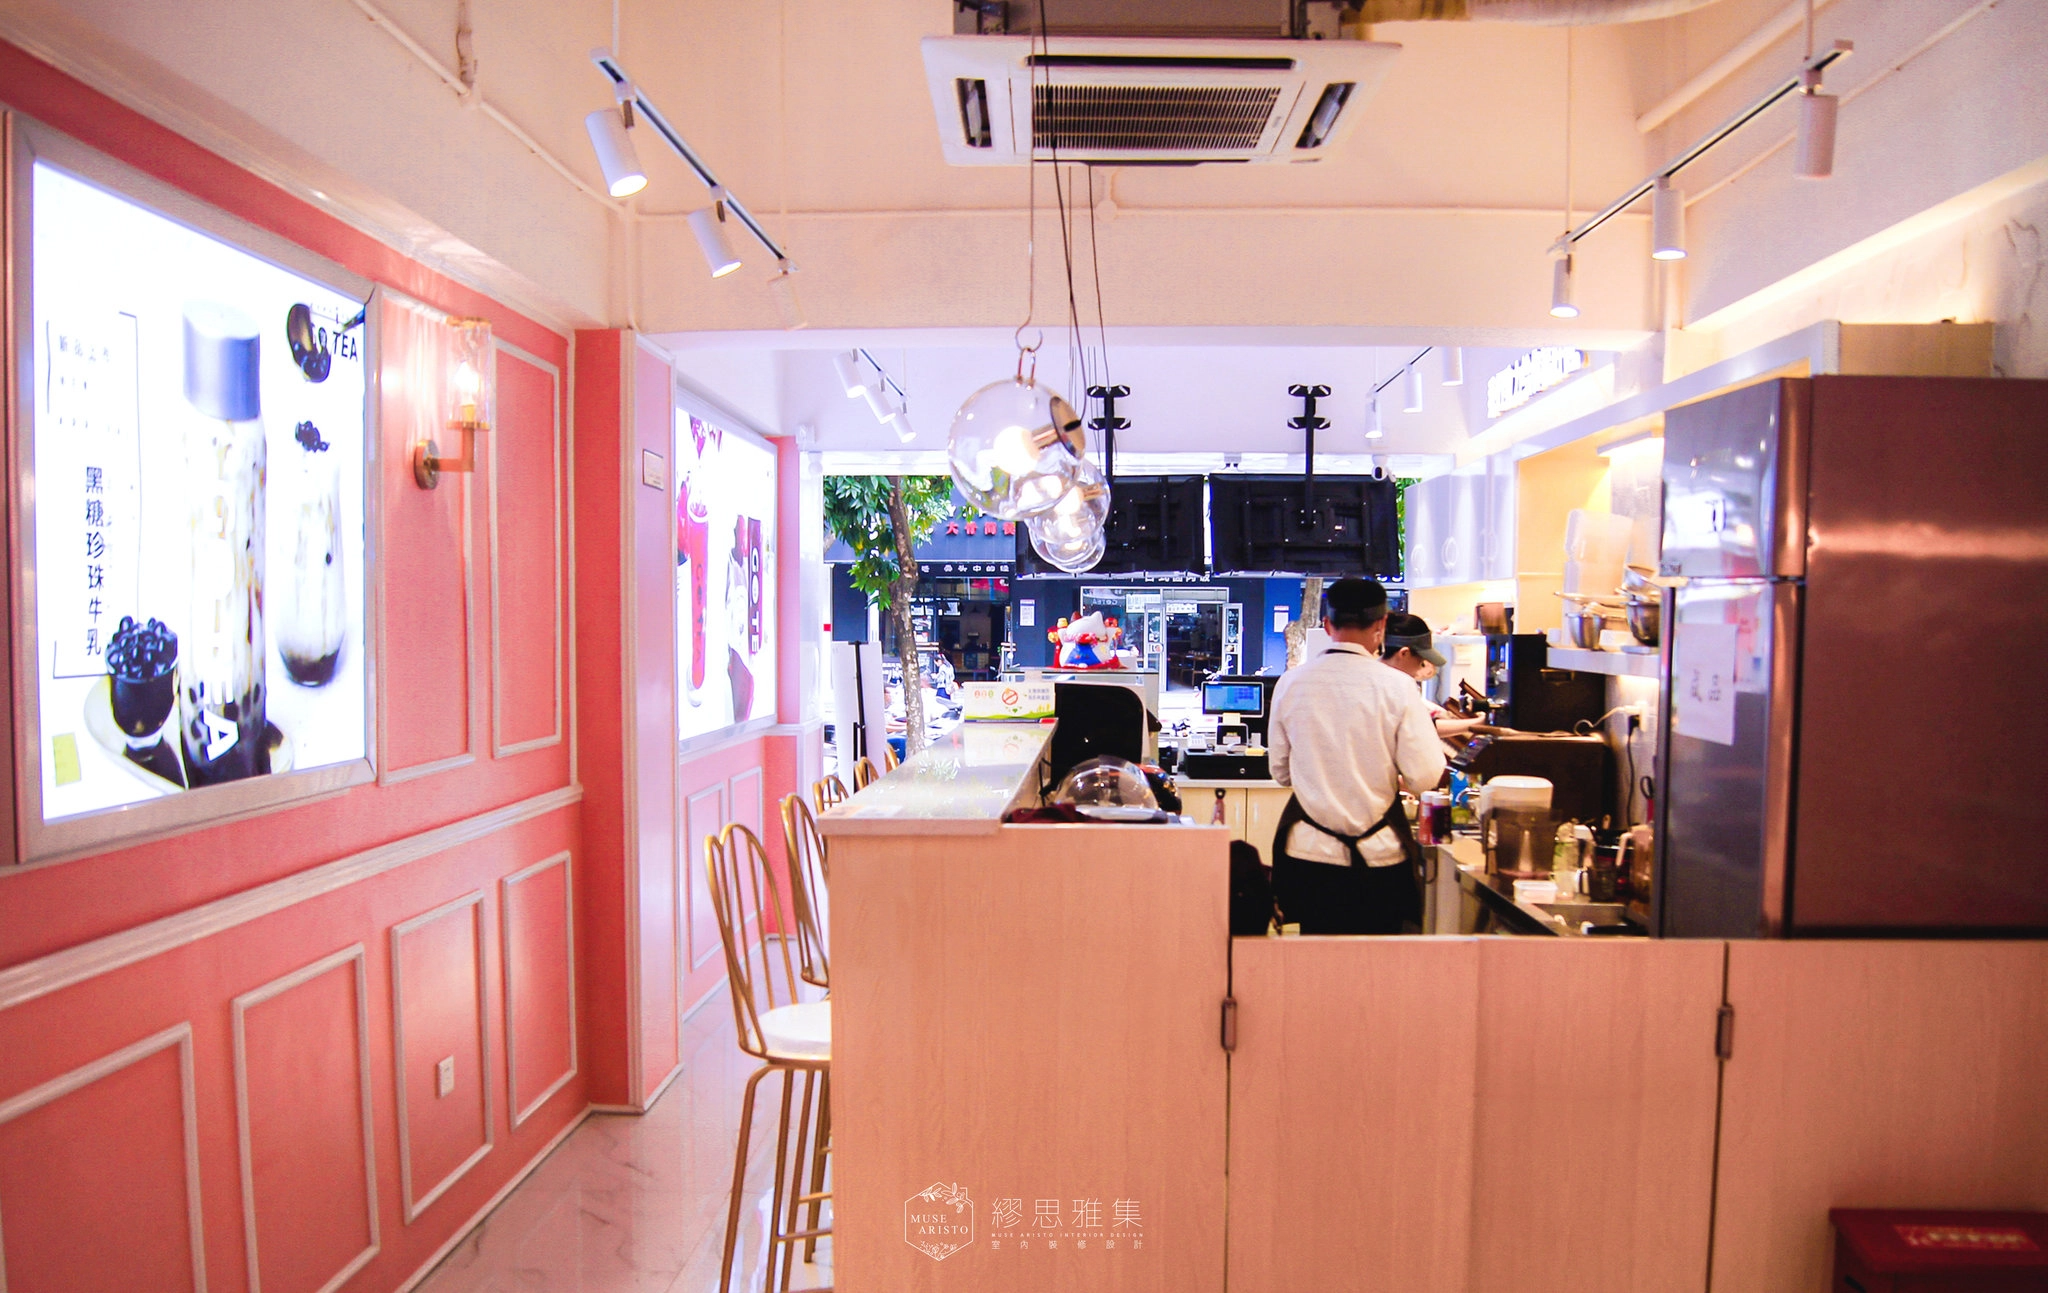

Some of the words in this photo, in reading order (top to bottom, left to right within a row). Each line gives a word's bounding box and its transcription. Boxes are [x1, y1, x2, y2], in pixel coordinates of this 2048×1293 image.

[332, 330, 358, 363] TEA
[86, 465, 105, 656] 黑糖珍珠牛乳
